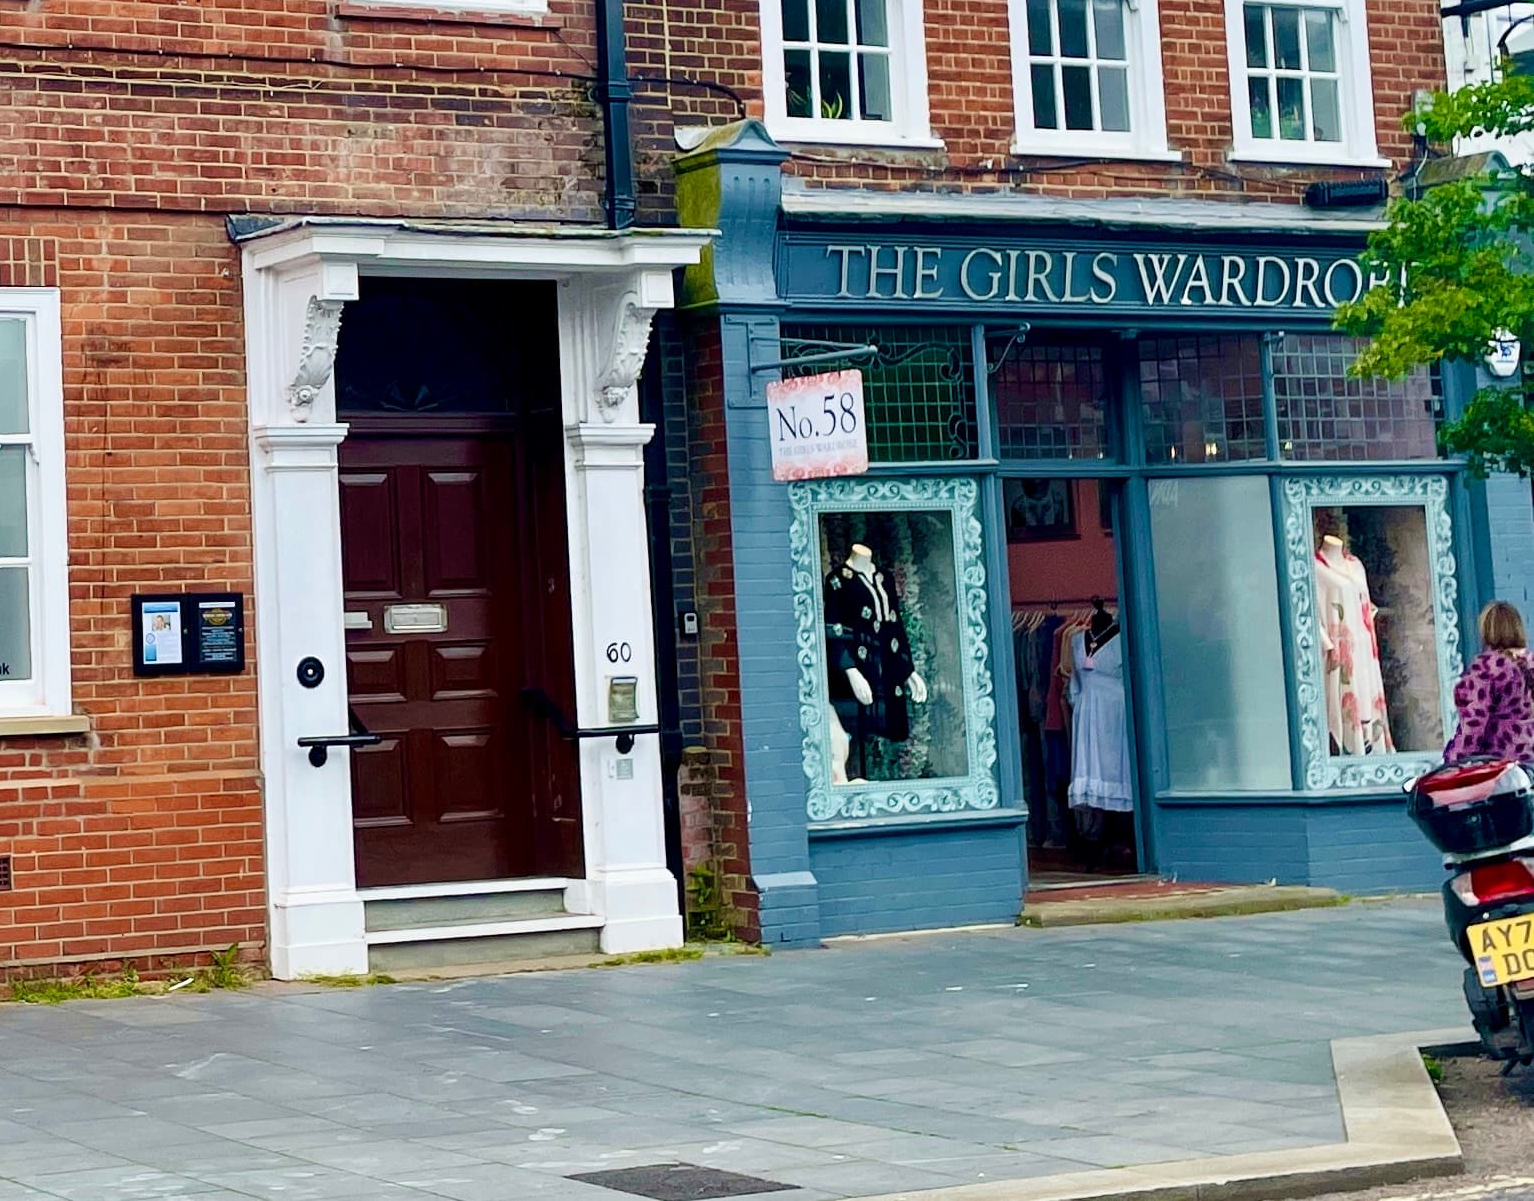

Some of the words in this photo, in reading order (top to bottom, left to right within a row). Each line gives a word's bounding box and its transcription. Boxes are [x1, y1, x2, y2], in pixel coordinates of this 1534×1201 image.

[827, 245, 943, 299] THE
[960, 249, 1116, 304] GIRLS
[606, 641, 632, 663] 60
